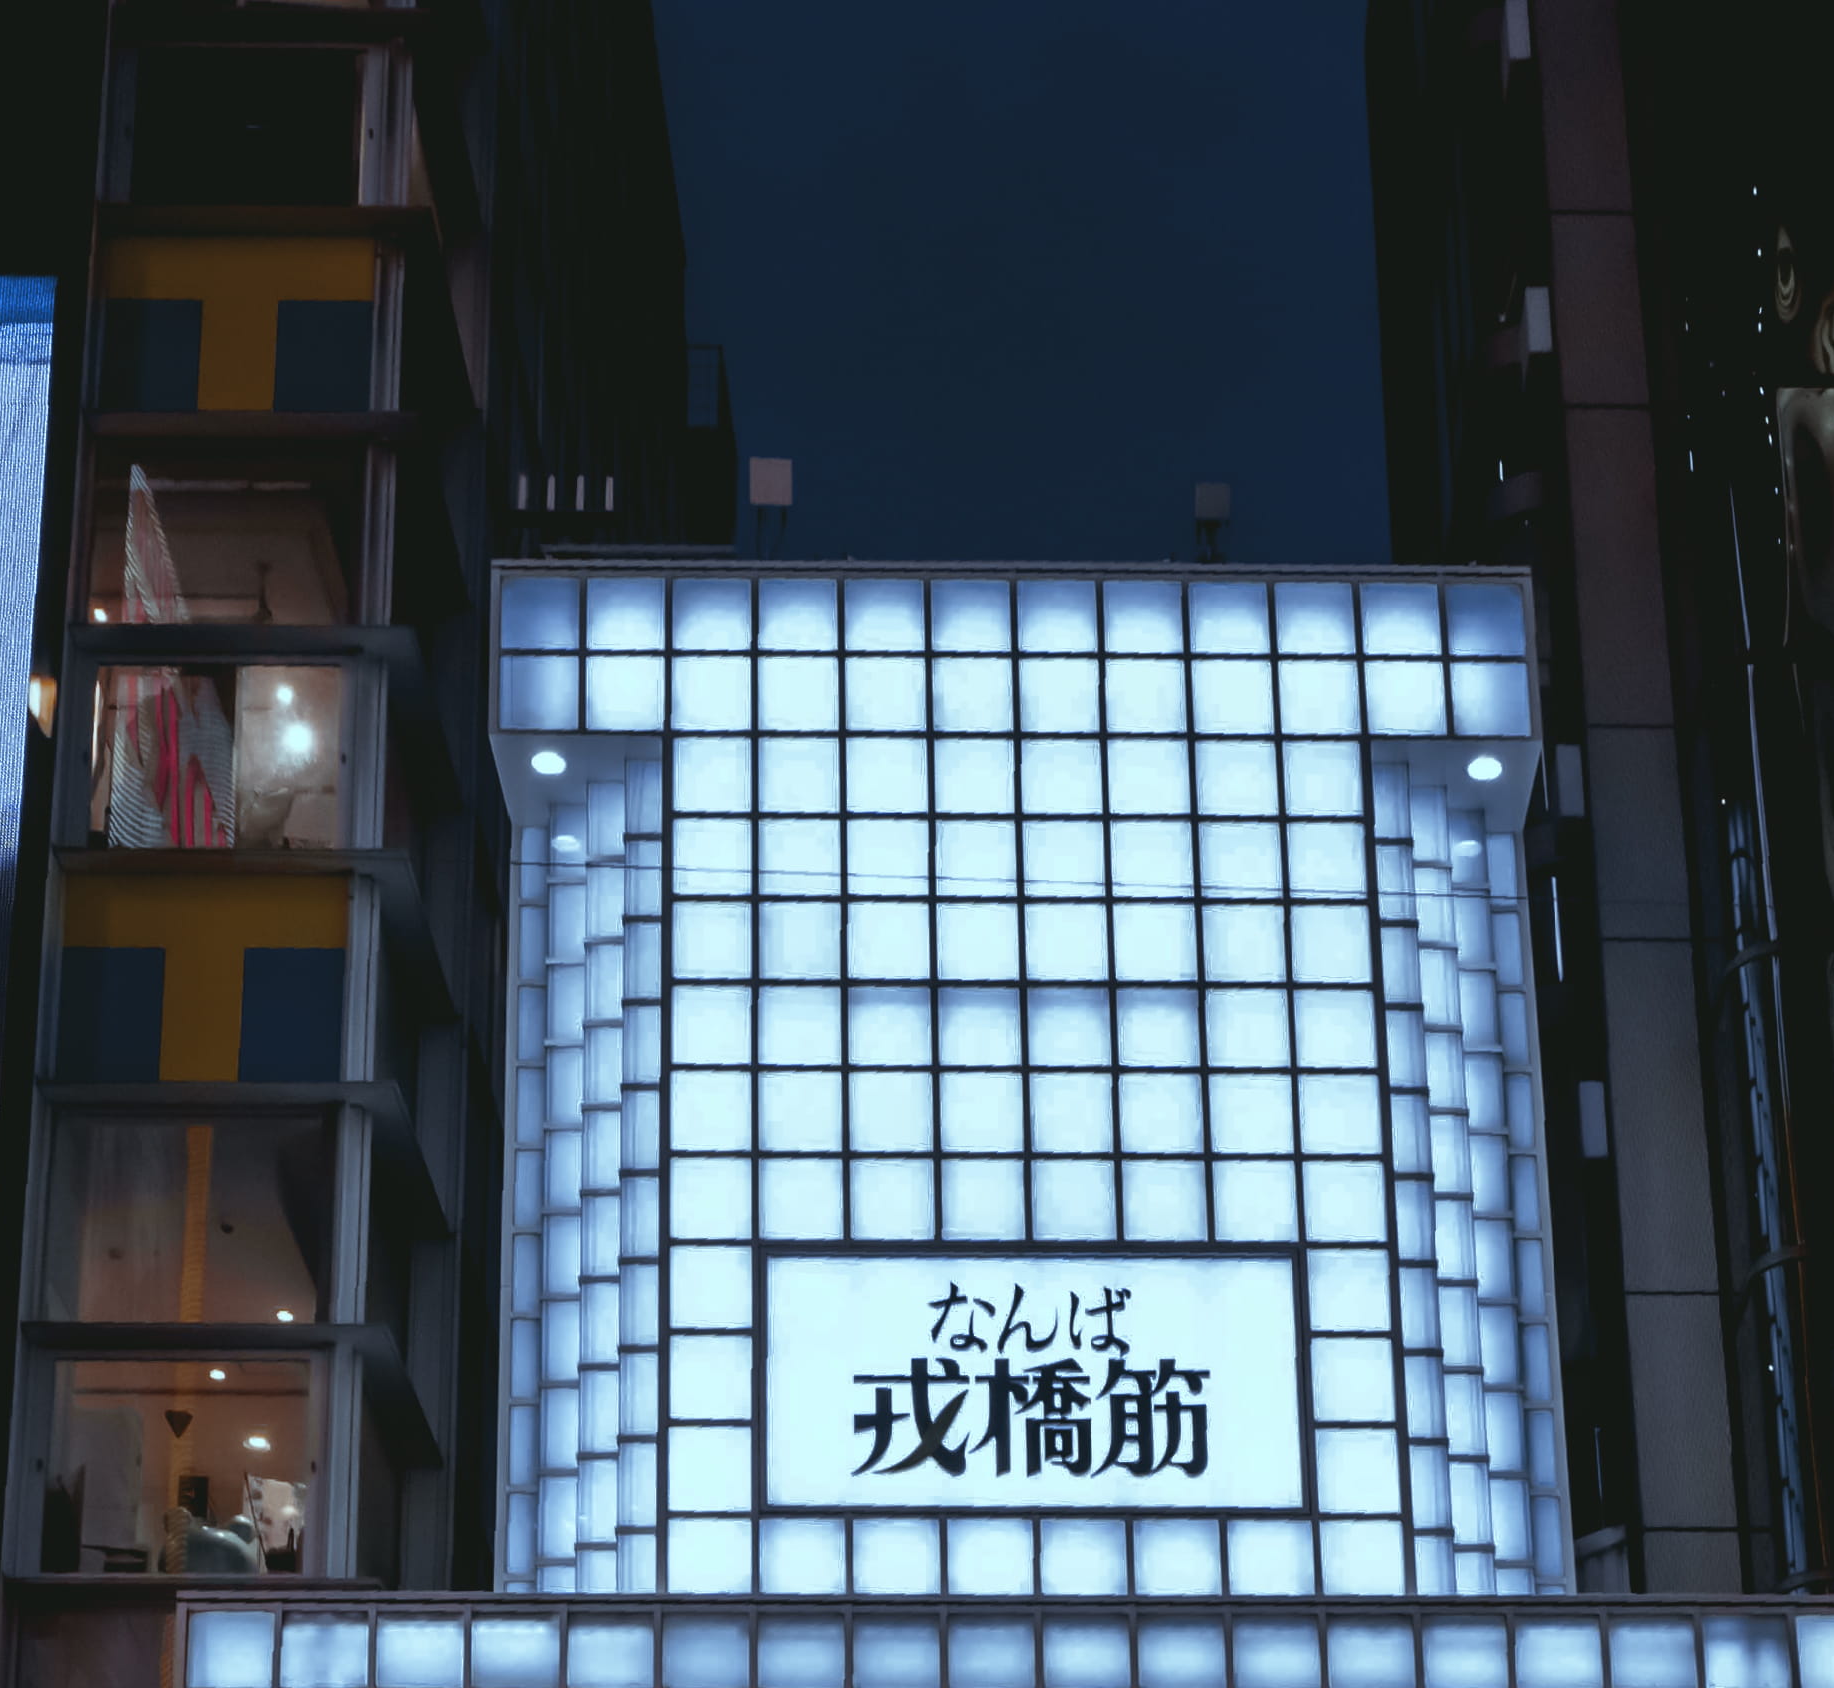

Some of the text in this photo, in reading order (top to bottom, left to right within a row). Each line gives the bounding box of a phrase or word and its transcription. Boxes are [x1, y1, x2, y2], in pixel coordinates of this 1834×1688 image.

[928, 1283, 1131, 1354] なんば
[851, 1358, 1210, 1478] 戎橋筋
